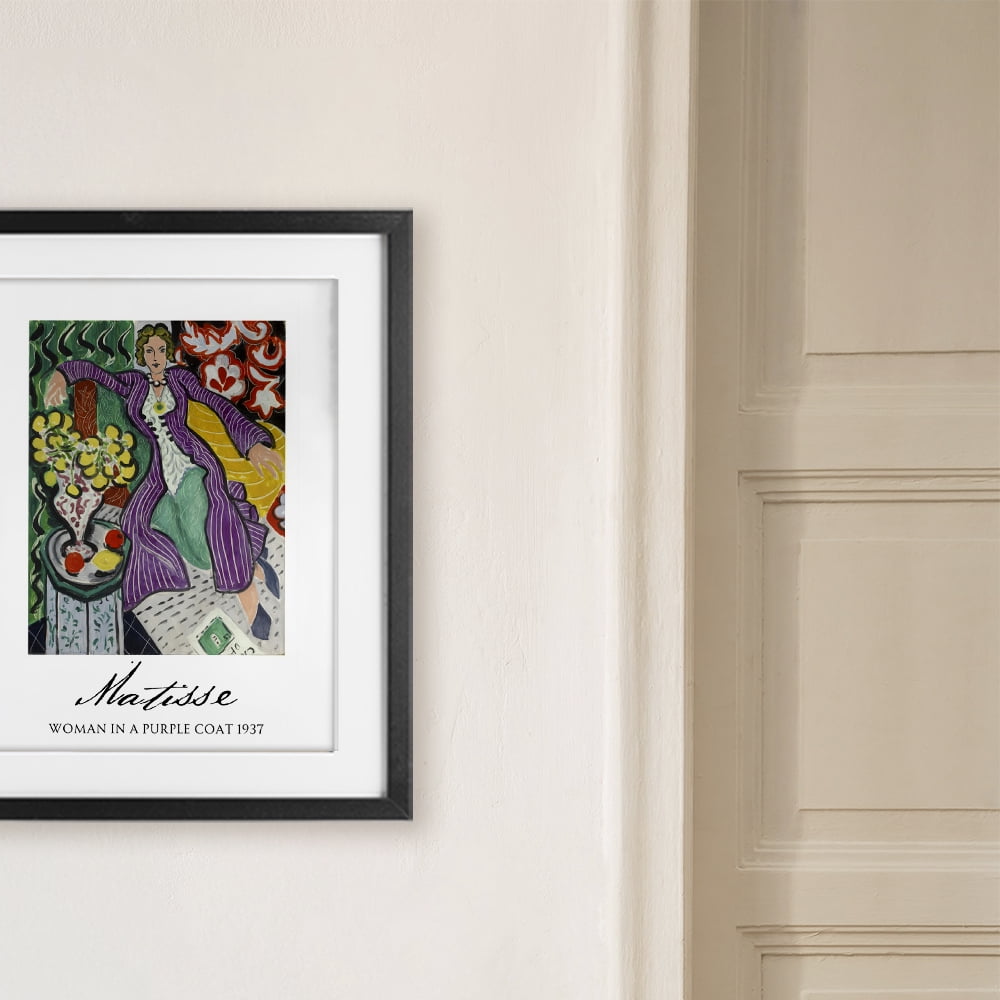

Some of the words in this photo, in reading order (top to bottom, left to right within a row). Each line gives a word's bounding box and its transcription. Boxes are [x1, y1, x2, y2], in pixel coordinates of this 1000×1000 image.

[75, 661, 238, 711] Matisse
[48, 723, 107, 735] WOMAN
[110, 723, 126, 735] IN
[129, 723, 139, 735] A
[142, 723, 191, 735] PURPLE
[194, 723, 234, 735] COAT
[236, 723, 265, 735] 1937
